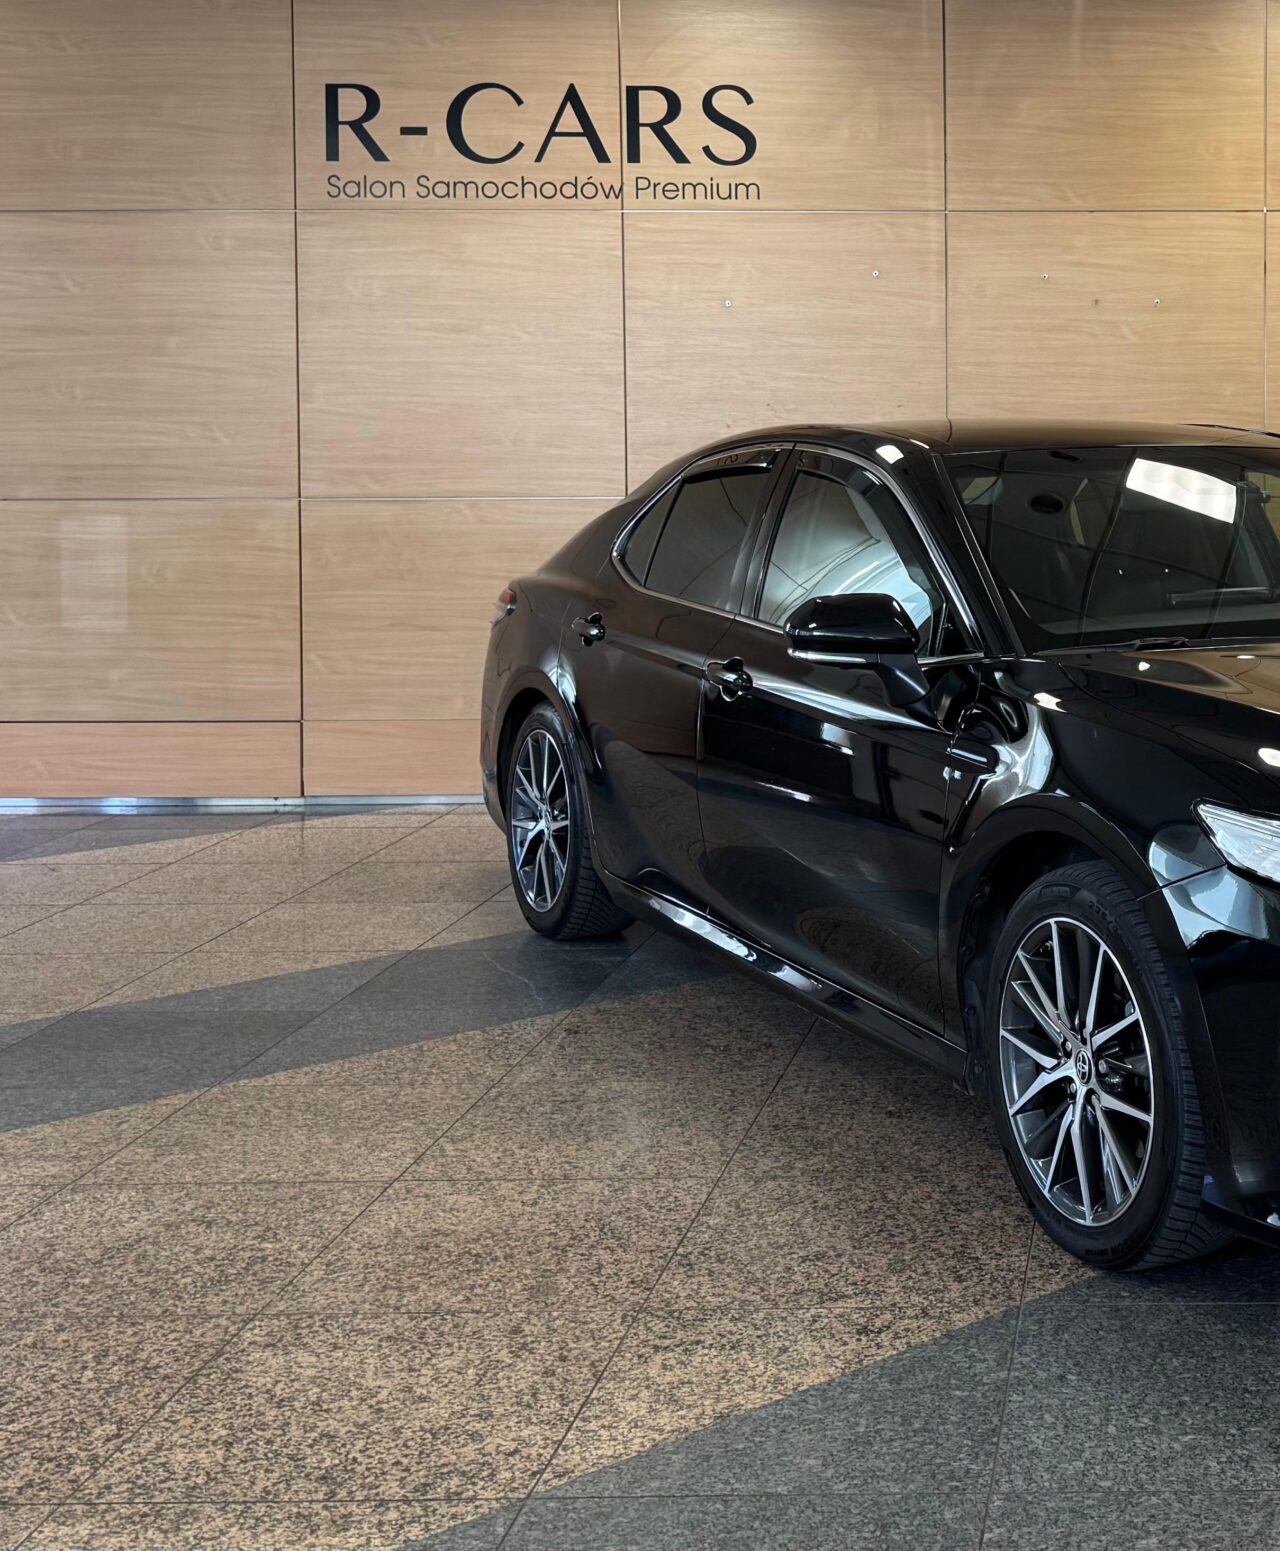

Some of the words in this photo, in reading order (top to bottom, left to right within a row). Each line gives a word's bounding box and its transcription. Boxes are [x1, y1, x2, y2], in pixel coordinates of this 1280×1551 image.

[325, 82, 757, 166] R-CARS
[327, 175, 405, 200] Salon
[416, 175, 624, 200] Samochodów
[636, 176, 761, 201] Premium
